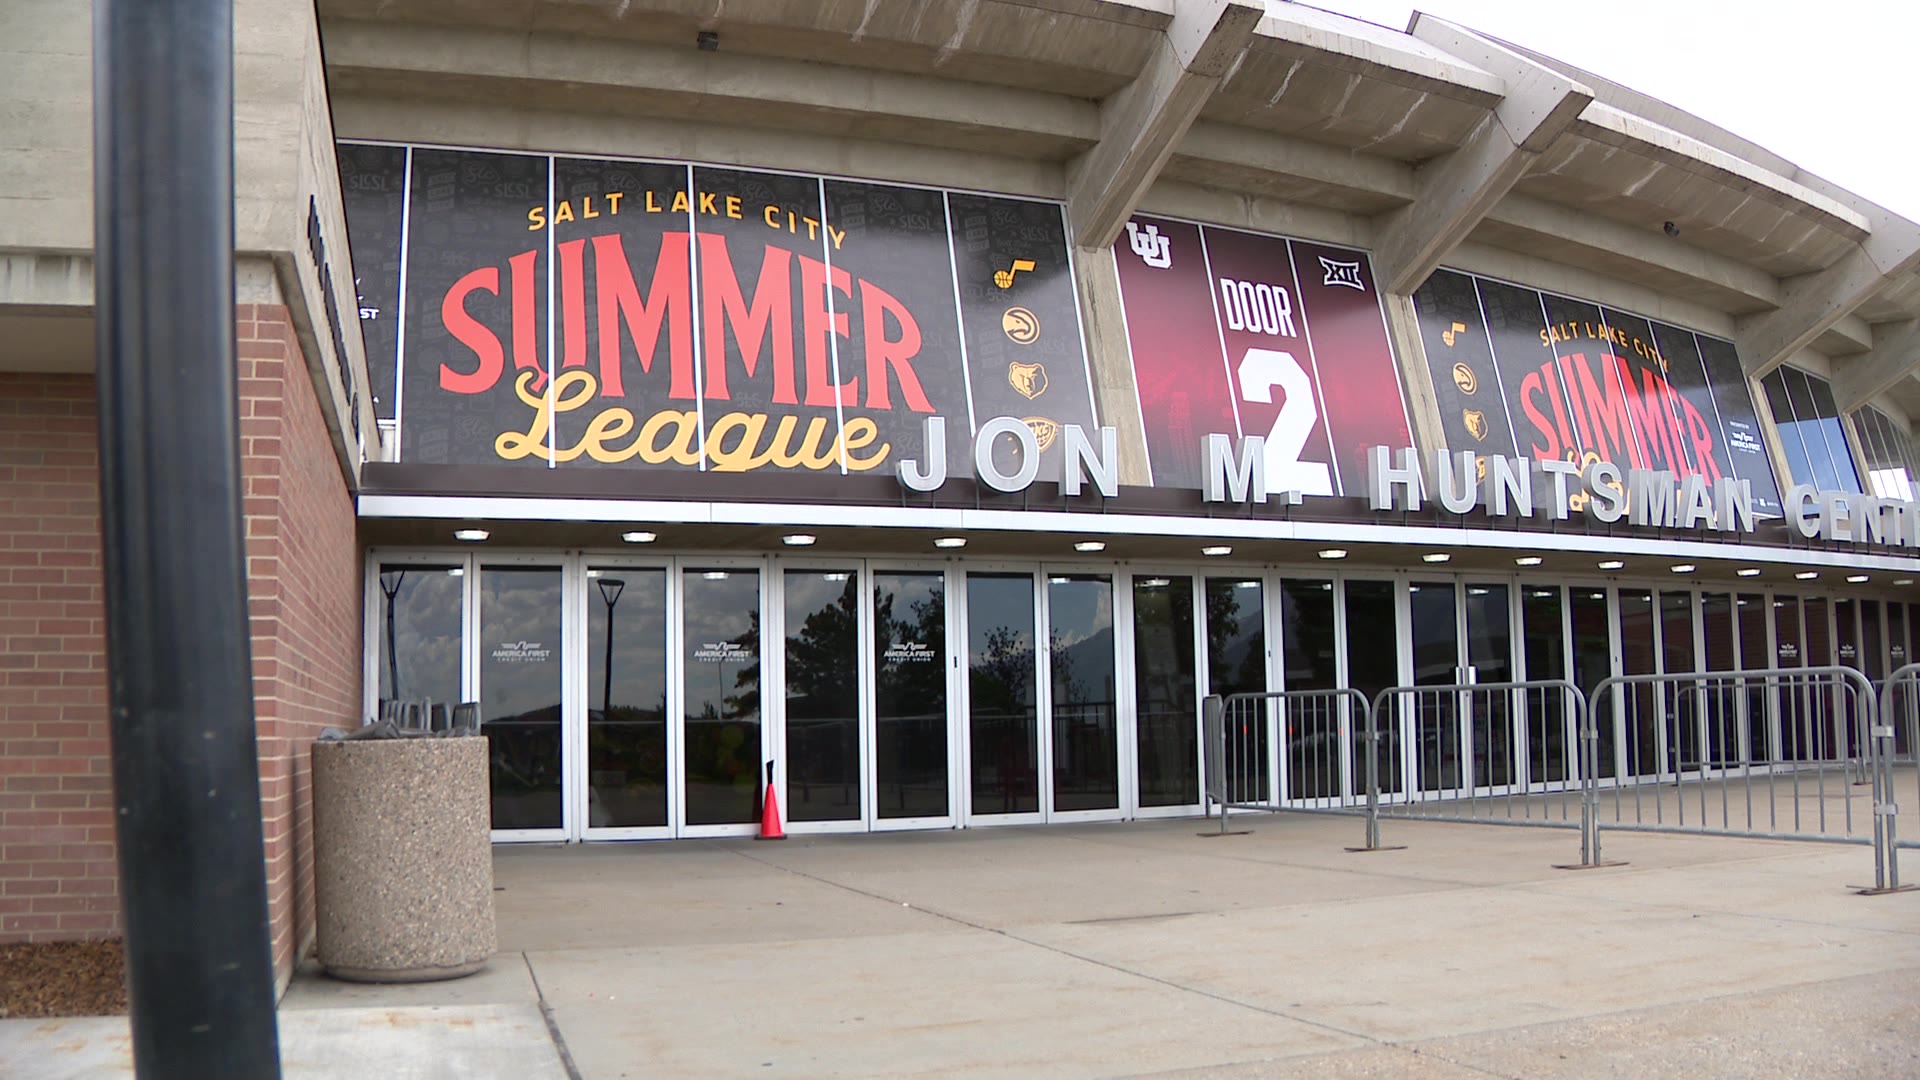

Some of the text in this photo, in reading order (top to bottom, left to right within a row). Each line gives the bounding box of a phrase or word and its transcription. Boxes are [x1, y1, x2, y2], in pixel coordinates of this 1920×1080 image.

[528, 192, 624, 231] SALT
[645, 190, 743, 220] LAKE
[764, 205, 846, 251] CITY
[439, 231, 937, 413] SUMMER
[1219, 277, 1297, 338] DOOR
[1540, 321, 1669, 373] SALT LAKE CITY
[494, 369, 891, 472] League
[895, 415, 1119, 498] JON
[1201, 432, 1304, 506] M.
[1367, 443, 1754, 533] HUNTSMAN
[1237, 347, 1335, 496] 2
[1519, 352, 1722, 487] SUMMER
